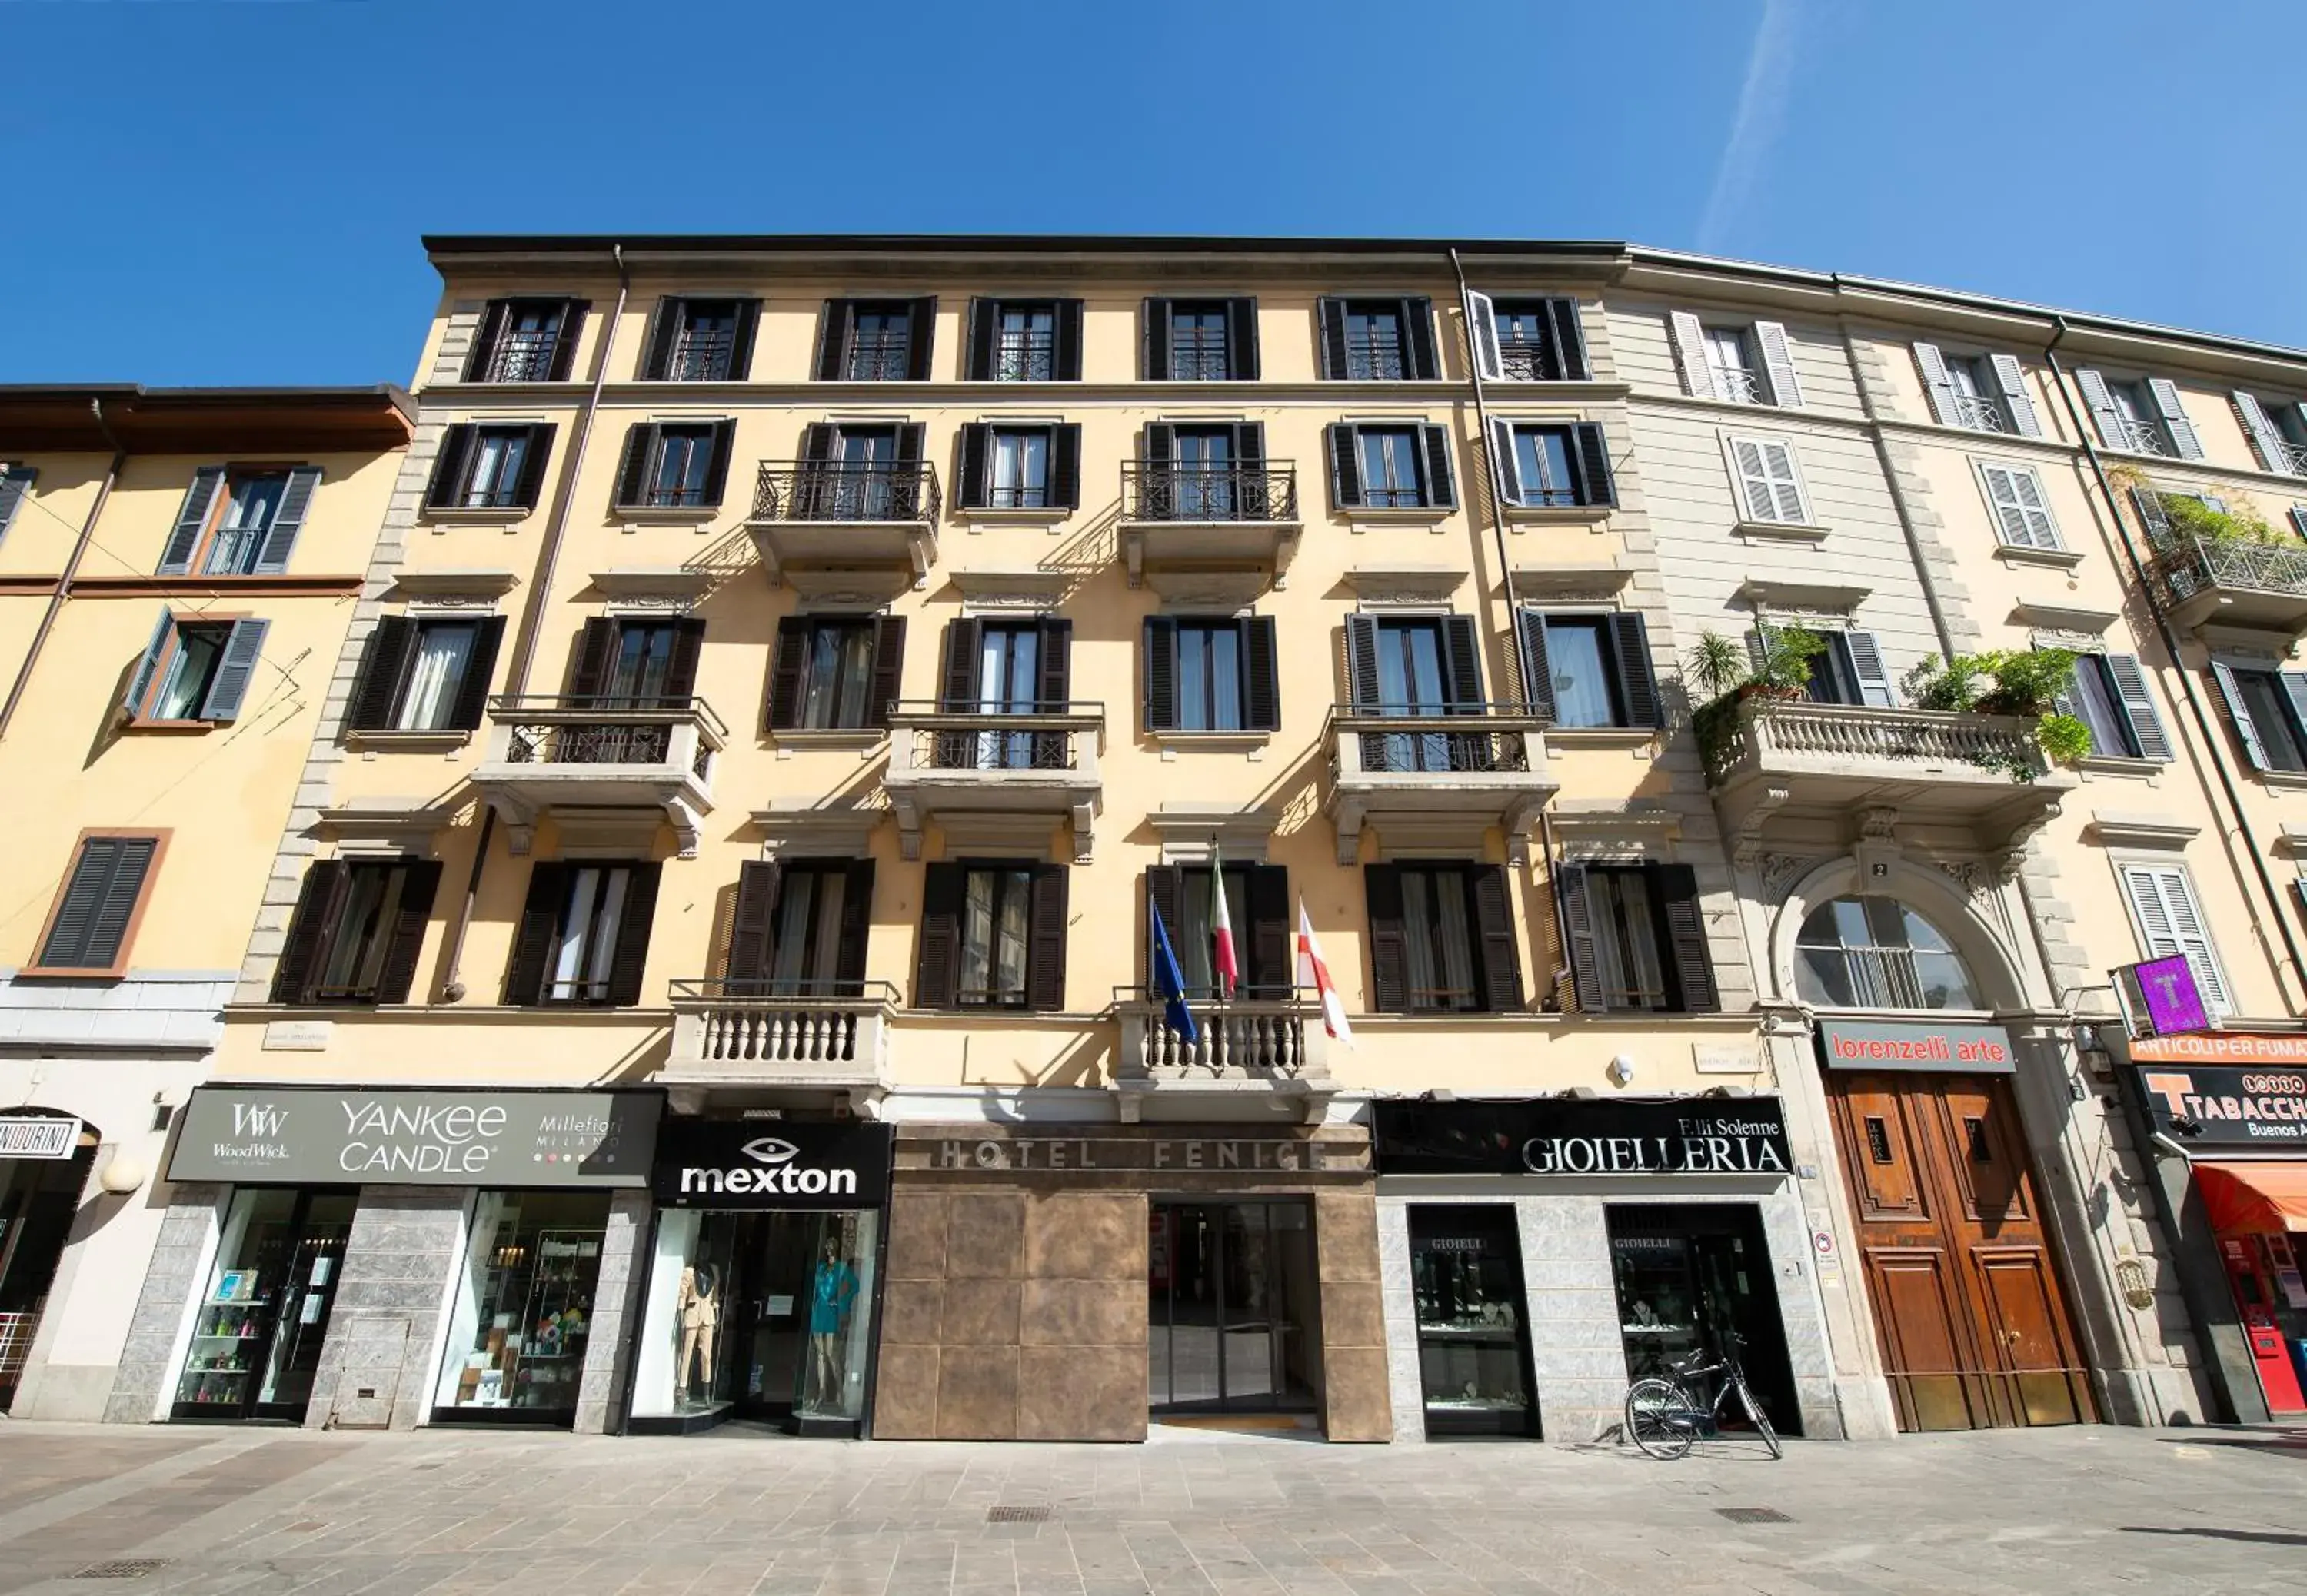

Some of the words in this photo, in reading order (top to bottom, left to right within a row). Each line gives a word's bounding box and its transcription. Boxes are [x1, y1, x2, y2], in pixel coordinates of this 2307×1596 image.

[1877, 865, 1884, 876] 2
[1833, 1033, 1950, 1062] lorenzelli
[1957, 1038, 2005, 1062] arte
[2136, 1037, 2215, 1056] ARTICOLI
[2215, 1039, 2255, 1056] PER
[2255, 1039, 2307, 1057] FUMA
[2242, 1075, 2306, 1094] LOTTO
[2185, 1096, 2307, 1120] TABACCH
[1716, 1119, 1780, 1135] Solenne
[2248, 1122, 2299, 1137] Buenos
[940, 1141, 1096, 1169] HOTEL
[1154, 1142, 1326, 1171] FENICE
[1522, 1137, 1788, 1172] GIOIELLERIA
[681, 1162, 857, 1194] mexton
